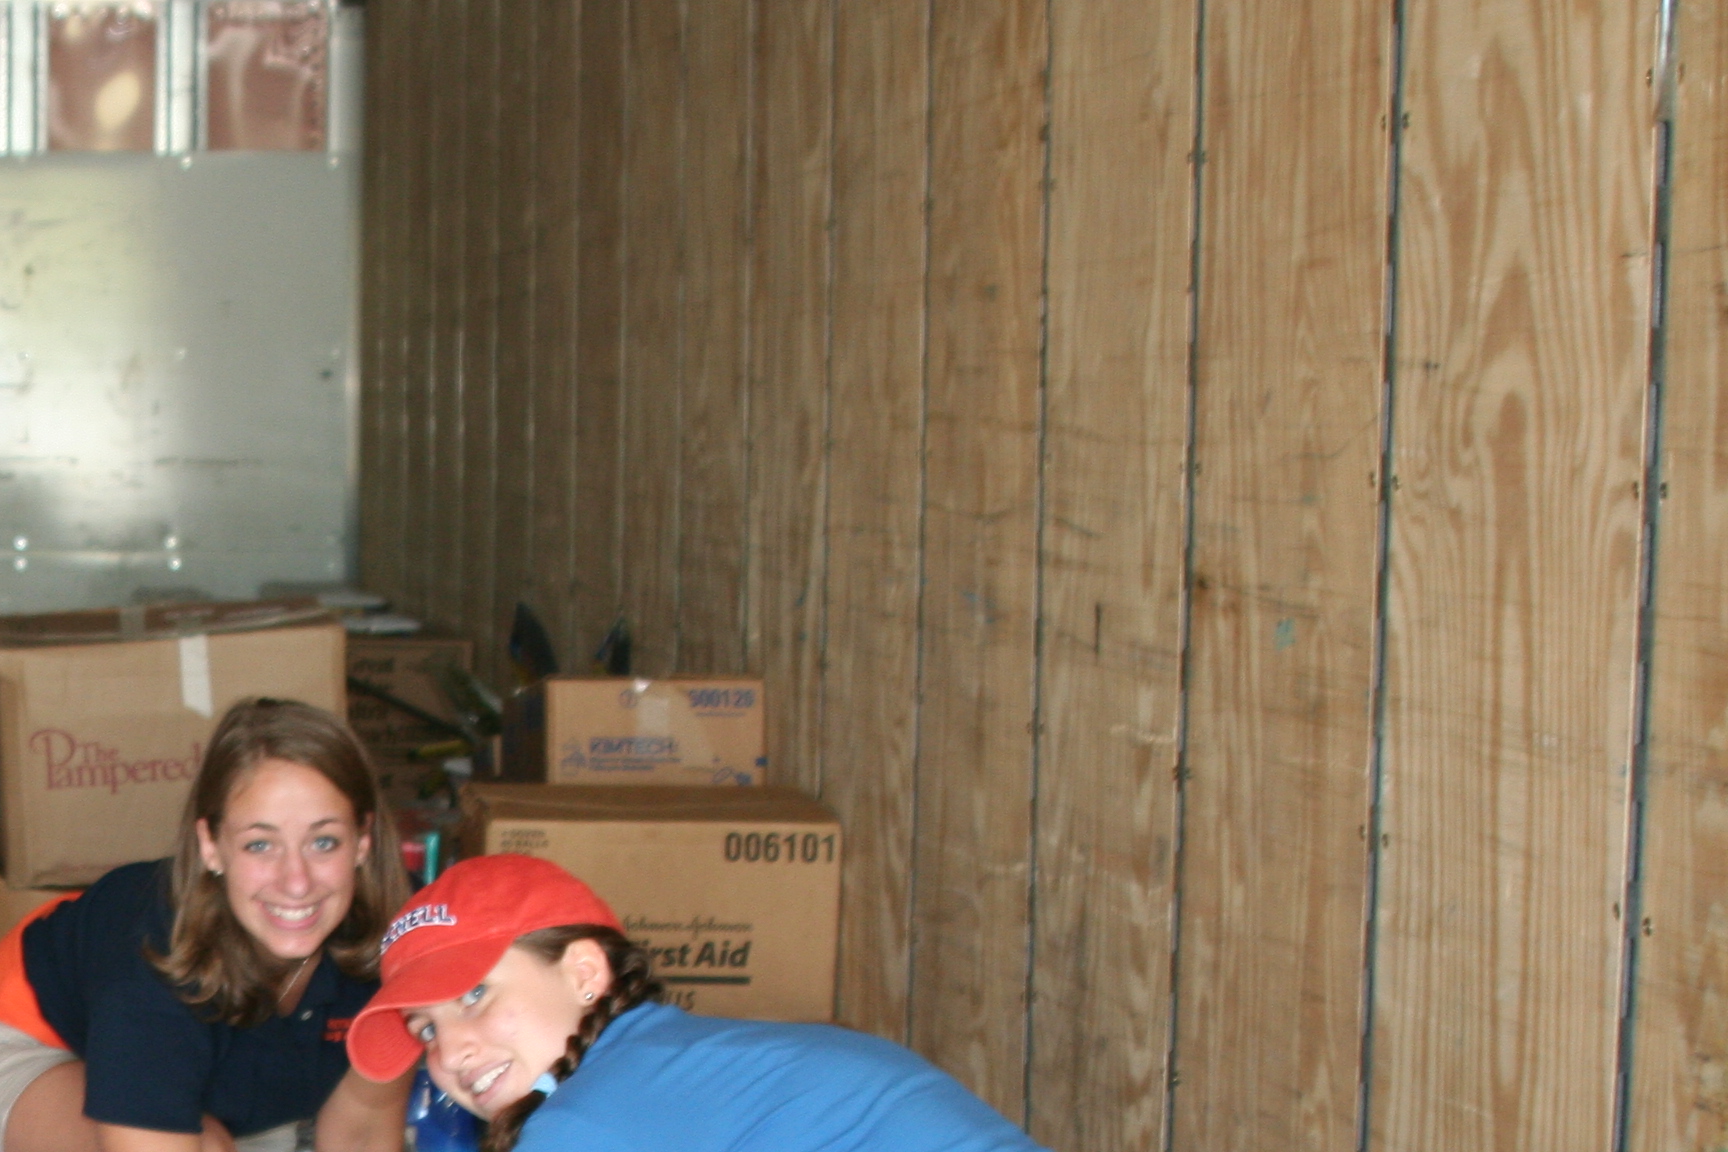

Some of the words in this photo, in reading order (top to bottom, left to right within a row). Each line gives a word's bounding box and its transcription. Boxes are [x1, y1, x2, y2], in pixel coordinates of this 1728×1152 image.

[29, 729, 201, 795] Pampered
[75, 741, 118, 763] The
[724, 831, 836, 864] 006101
[692, 941, 752, 968] Aid
